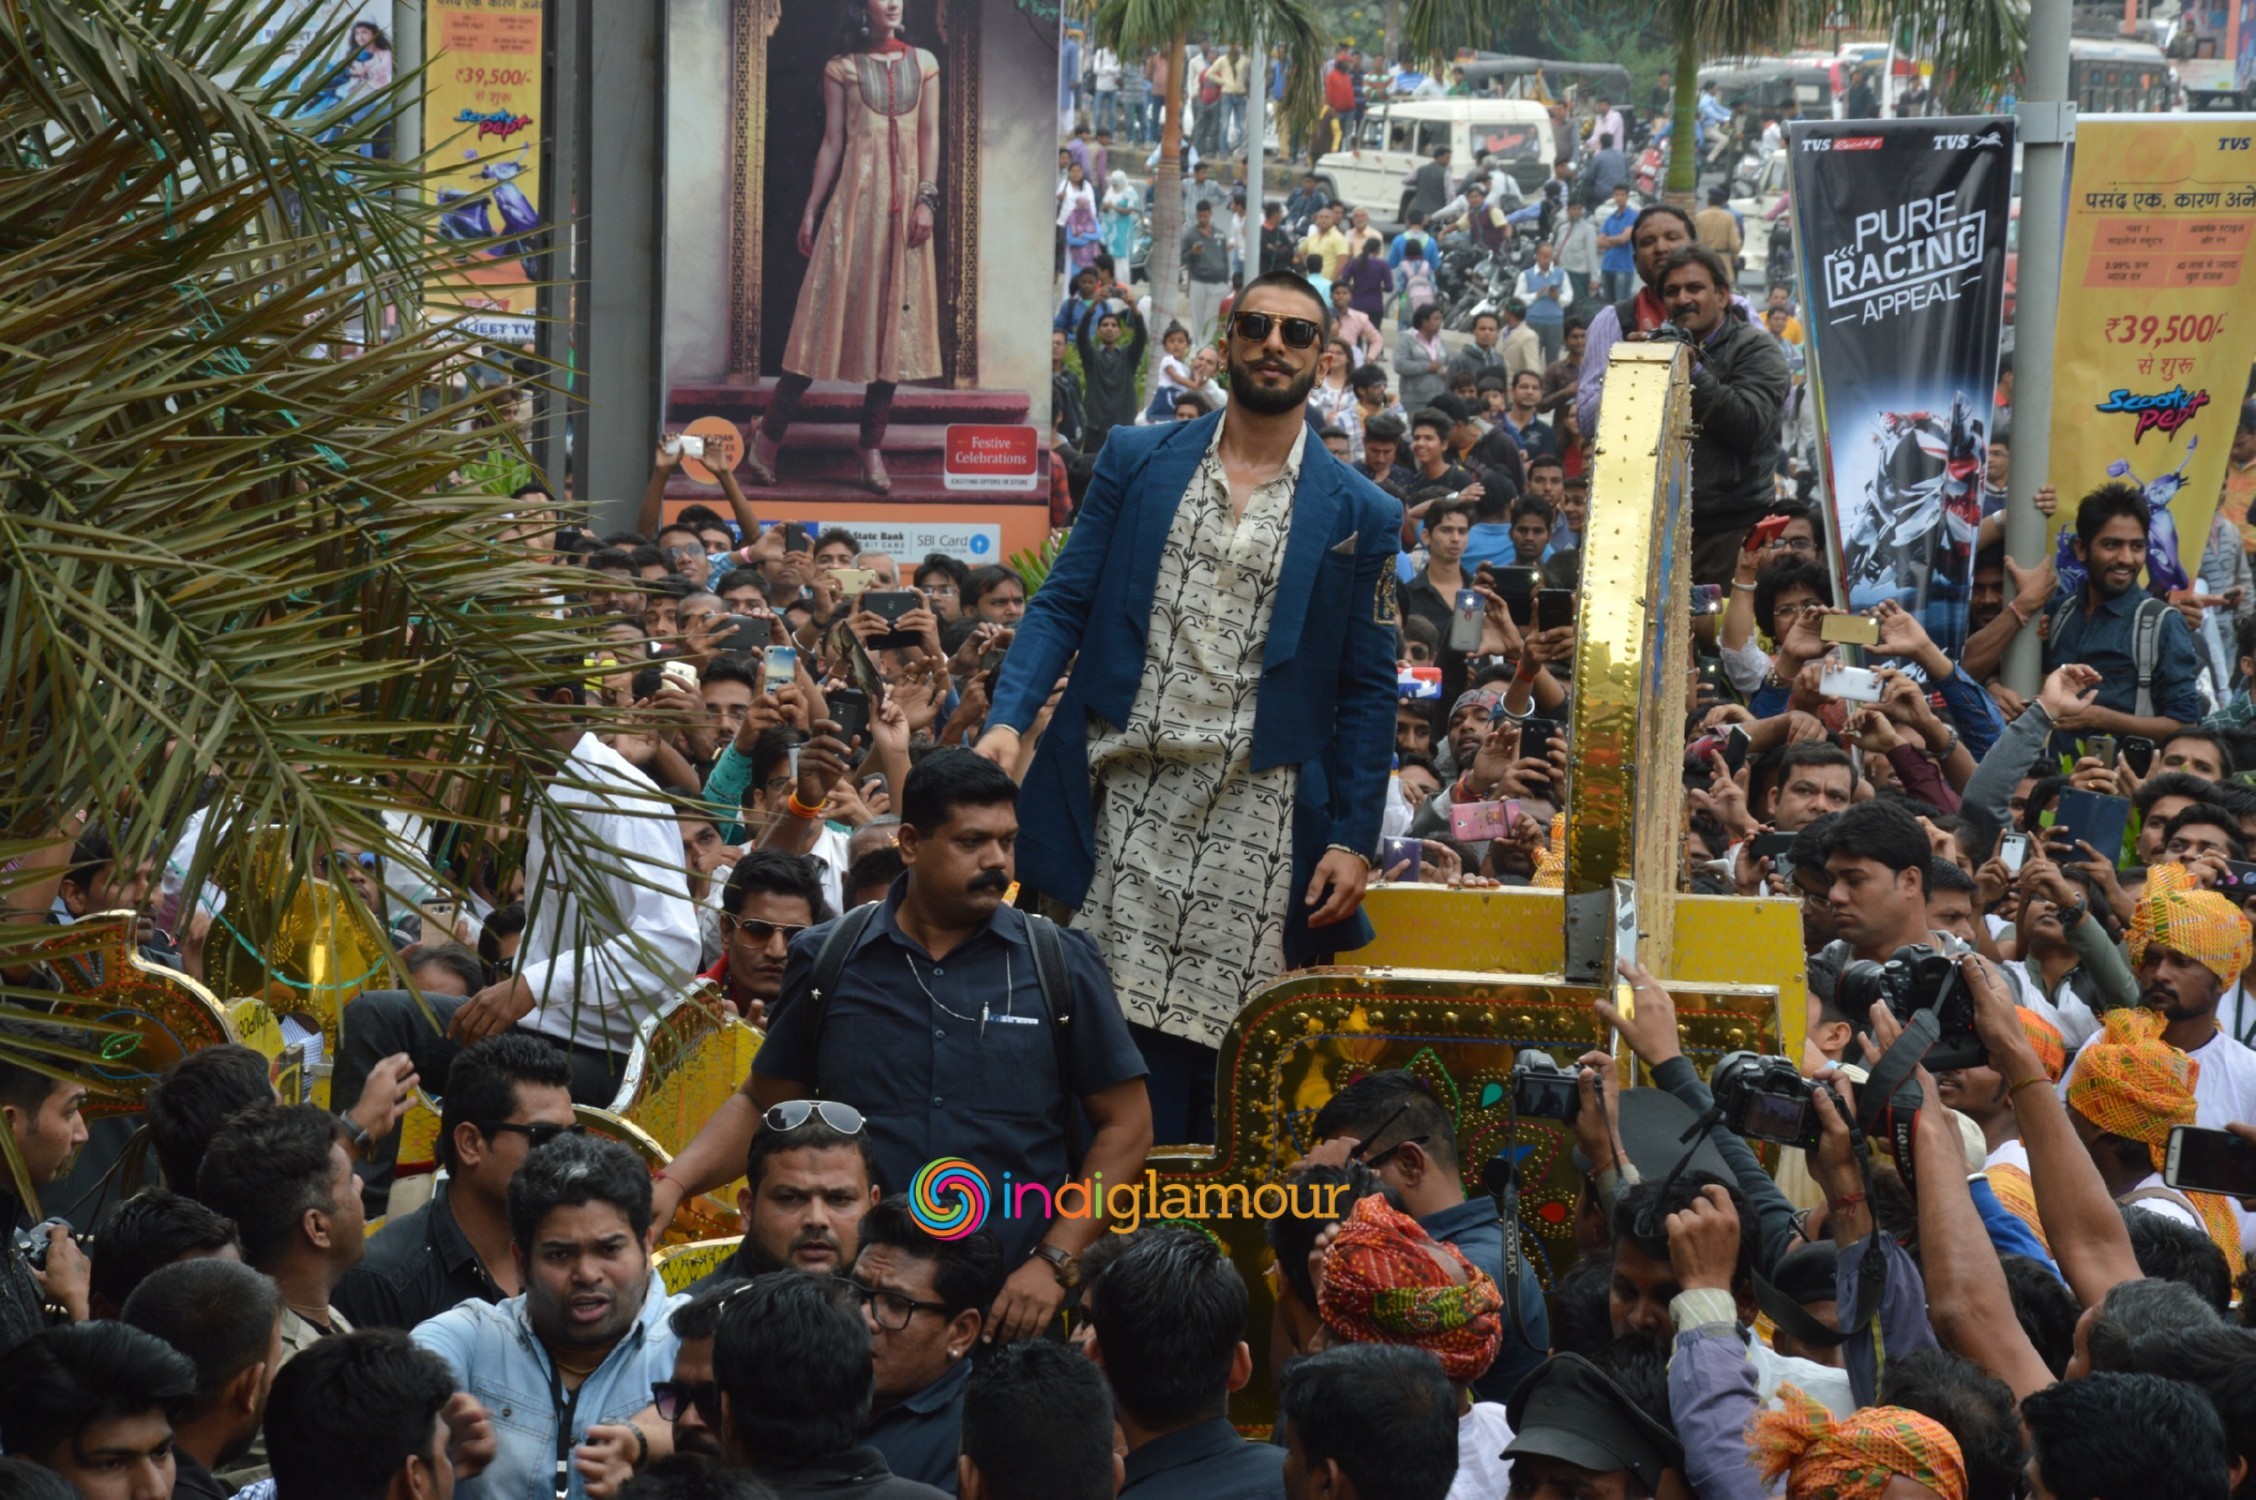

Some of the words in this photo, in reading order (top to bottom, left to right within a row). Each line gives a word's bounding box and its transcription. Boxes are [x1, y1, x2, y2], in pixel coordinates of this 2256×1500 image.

[1802, 138, 1832, 151] TVS
[1834, 137, 1883, 151] Racing
[1933, 134, 1971, 150] TVS
[2218, 137, 2252, 150] TVS
[2086, 188, 2128, 210] पसंद
[2174, 193, 2221, 209] कारण
[1855, 190, 1957, 253] PURE
[1834, 223, 1976, 296] RACING
[1862, 277, 1961, 326] APPEAL
[2137, 352, 2155, 375] से
[2161, 357, 2196, 381] शुरू
[2095, 383, 2196, 414] Scooty
[972, 435, 1012, 450] Festive
[955, 451, 1028, 466] Celebrations
[853, 531, 877, 540] State
[881, 531, 904, 540] Bank
[917, 534, 935, 546] SBI
[939, 534, 968, 547] Card
[1506, 1220, 1519, 1275] COOLPIX
